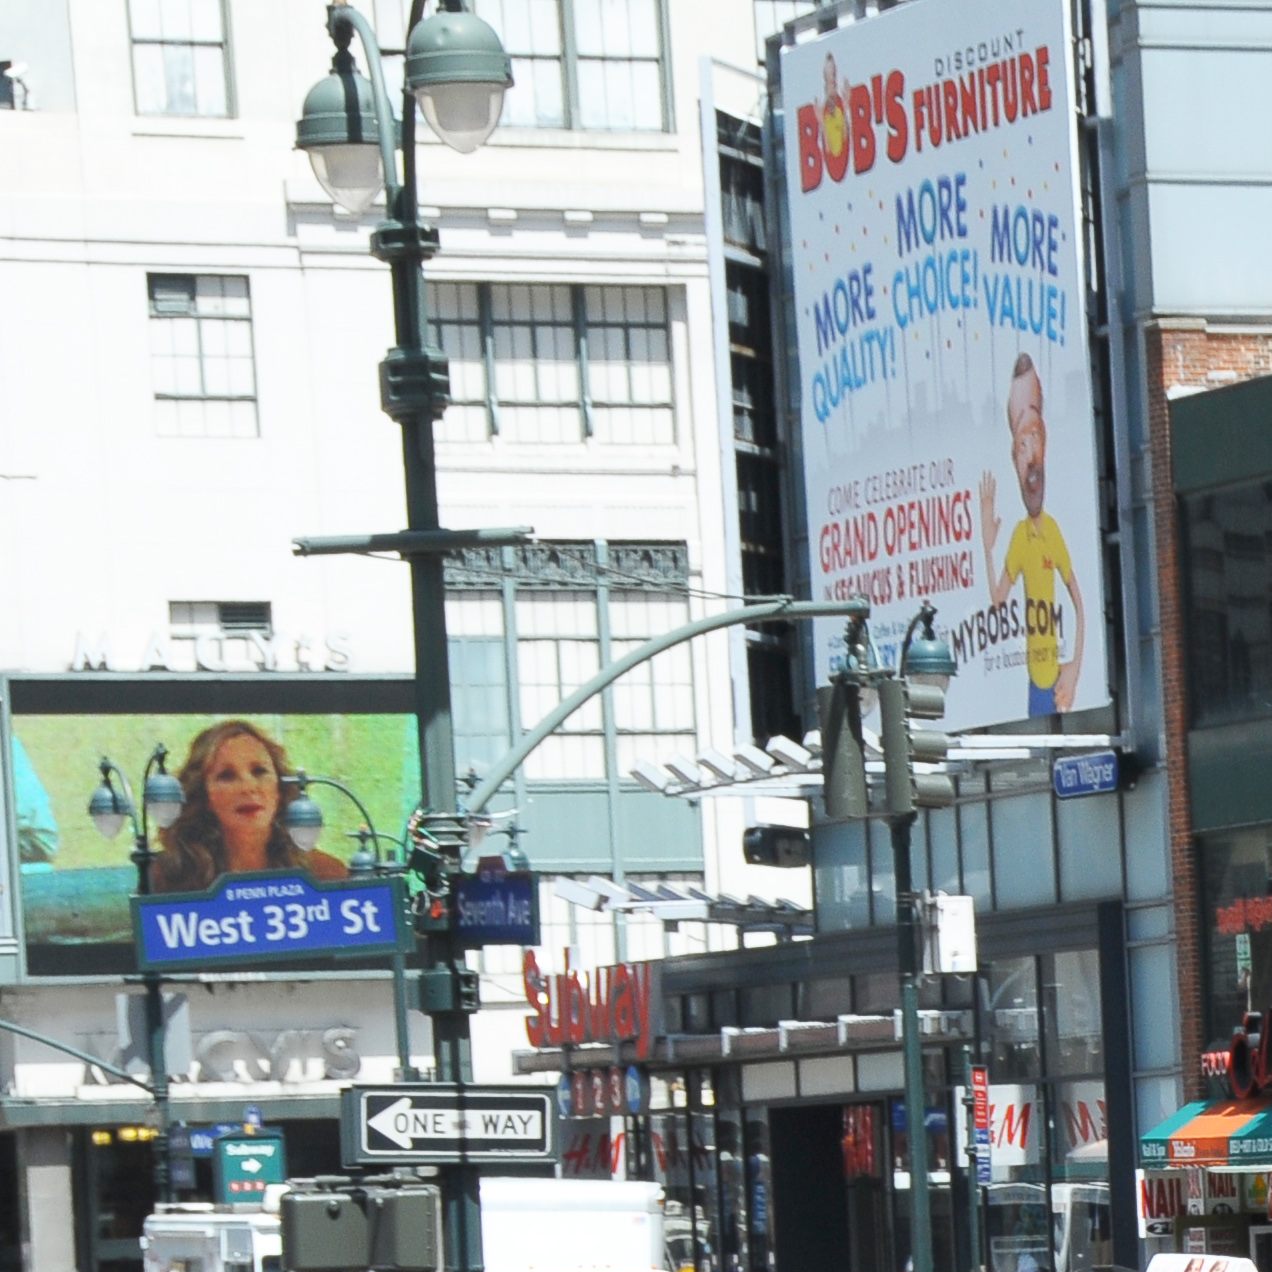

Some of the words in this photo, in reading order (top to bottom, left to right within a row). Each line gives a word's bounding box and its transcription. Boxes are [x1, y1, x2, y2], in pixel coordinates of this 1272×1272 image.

[934, 29, 1025, 77] DISCOUNT
[796, 69, 908, 194] BOB'S
[912, 45, 1052, 152] FURNITURE
[896, 172, 968, 257] MORE
[990, 204, 1060, 277] MORE
[813, 263, 876, 356] MORE
[892, 248, 978, 330] CHOICE!
[983, 274, 1066, 347] VALUE!
[812, 325, 896, 422] QUALITY!
[864, 464, 928, 505] CELEBRATE
[930, 458, 955, 489] OUR
[819, 511, 878, 574] GRAND
[884, 490, 973, 556] OPENINGS
[909, 552, 975, 599] FLUSHING!
[950, 597, 1064, 664] MYBOBS.COM
[157, 906, 256, 949] West
[263, 898, 332, 943] 33rd
[340, 898, 380, 934] St
[523, 946, 652, 1060] Subway
[394, 1111, 447, 1134] ONE
[480, 1113, 534, 1136] WAY
